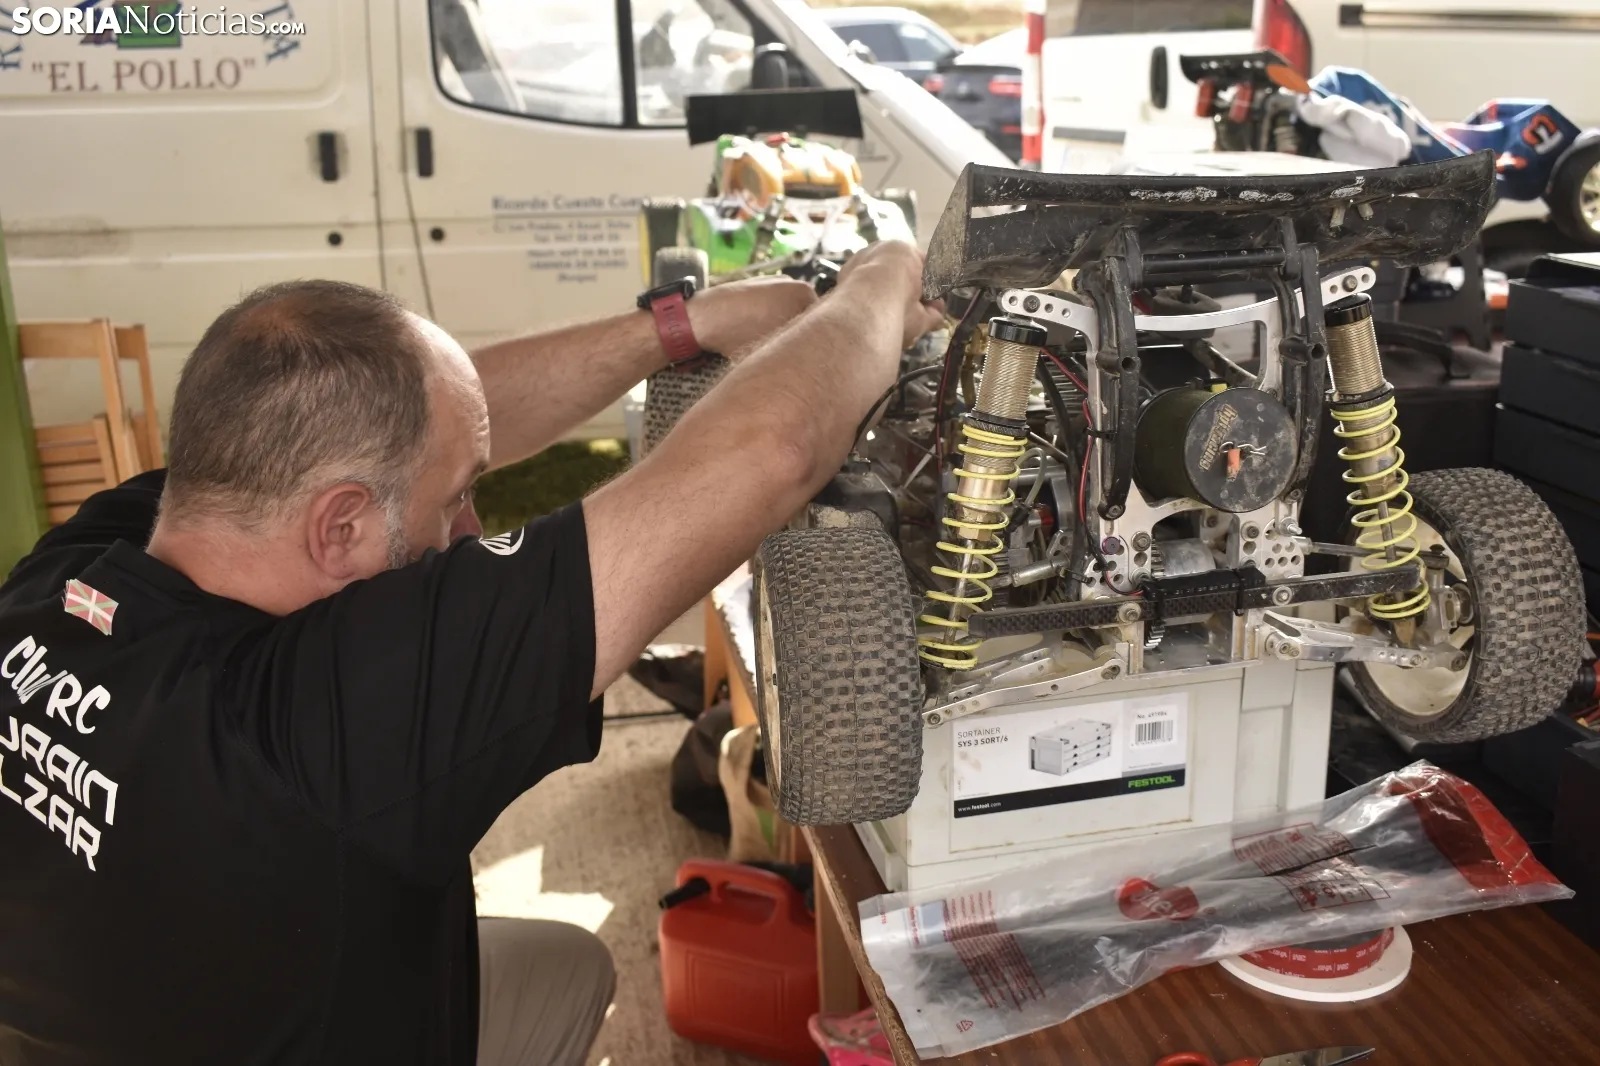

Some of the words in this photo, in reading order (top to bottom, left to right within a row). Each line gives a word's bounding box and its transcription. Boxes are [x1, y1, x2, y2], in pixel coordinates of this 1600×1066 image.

[31, 60, 99, 92] "EL
[113, 57, 257, 91] POLLO"
[957, 726, 1001, 739] SORTAINER
[957, 739, 972, 748] SYS
[980, 734, 1009, 745] SORT/6
[1128, 774, 1174, 788] FESTOOL
